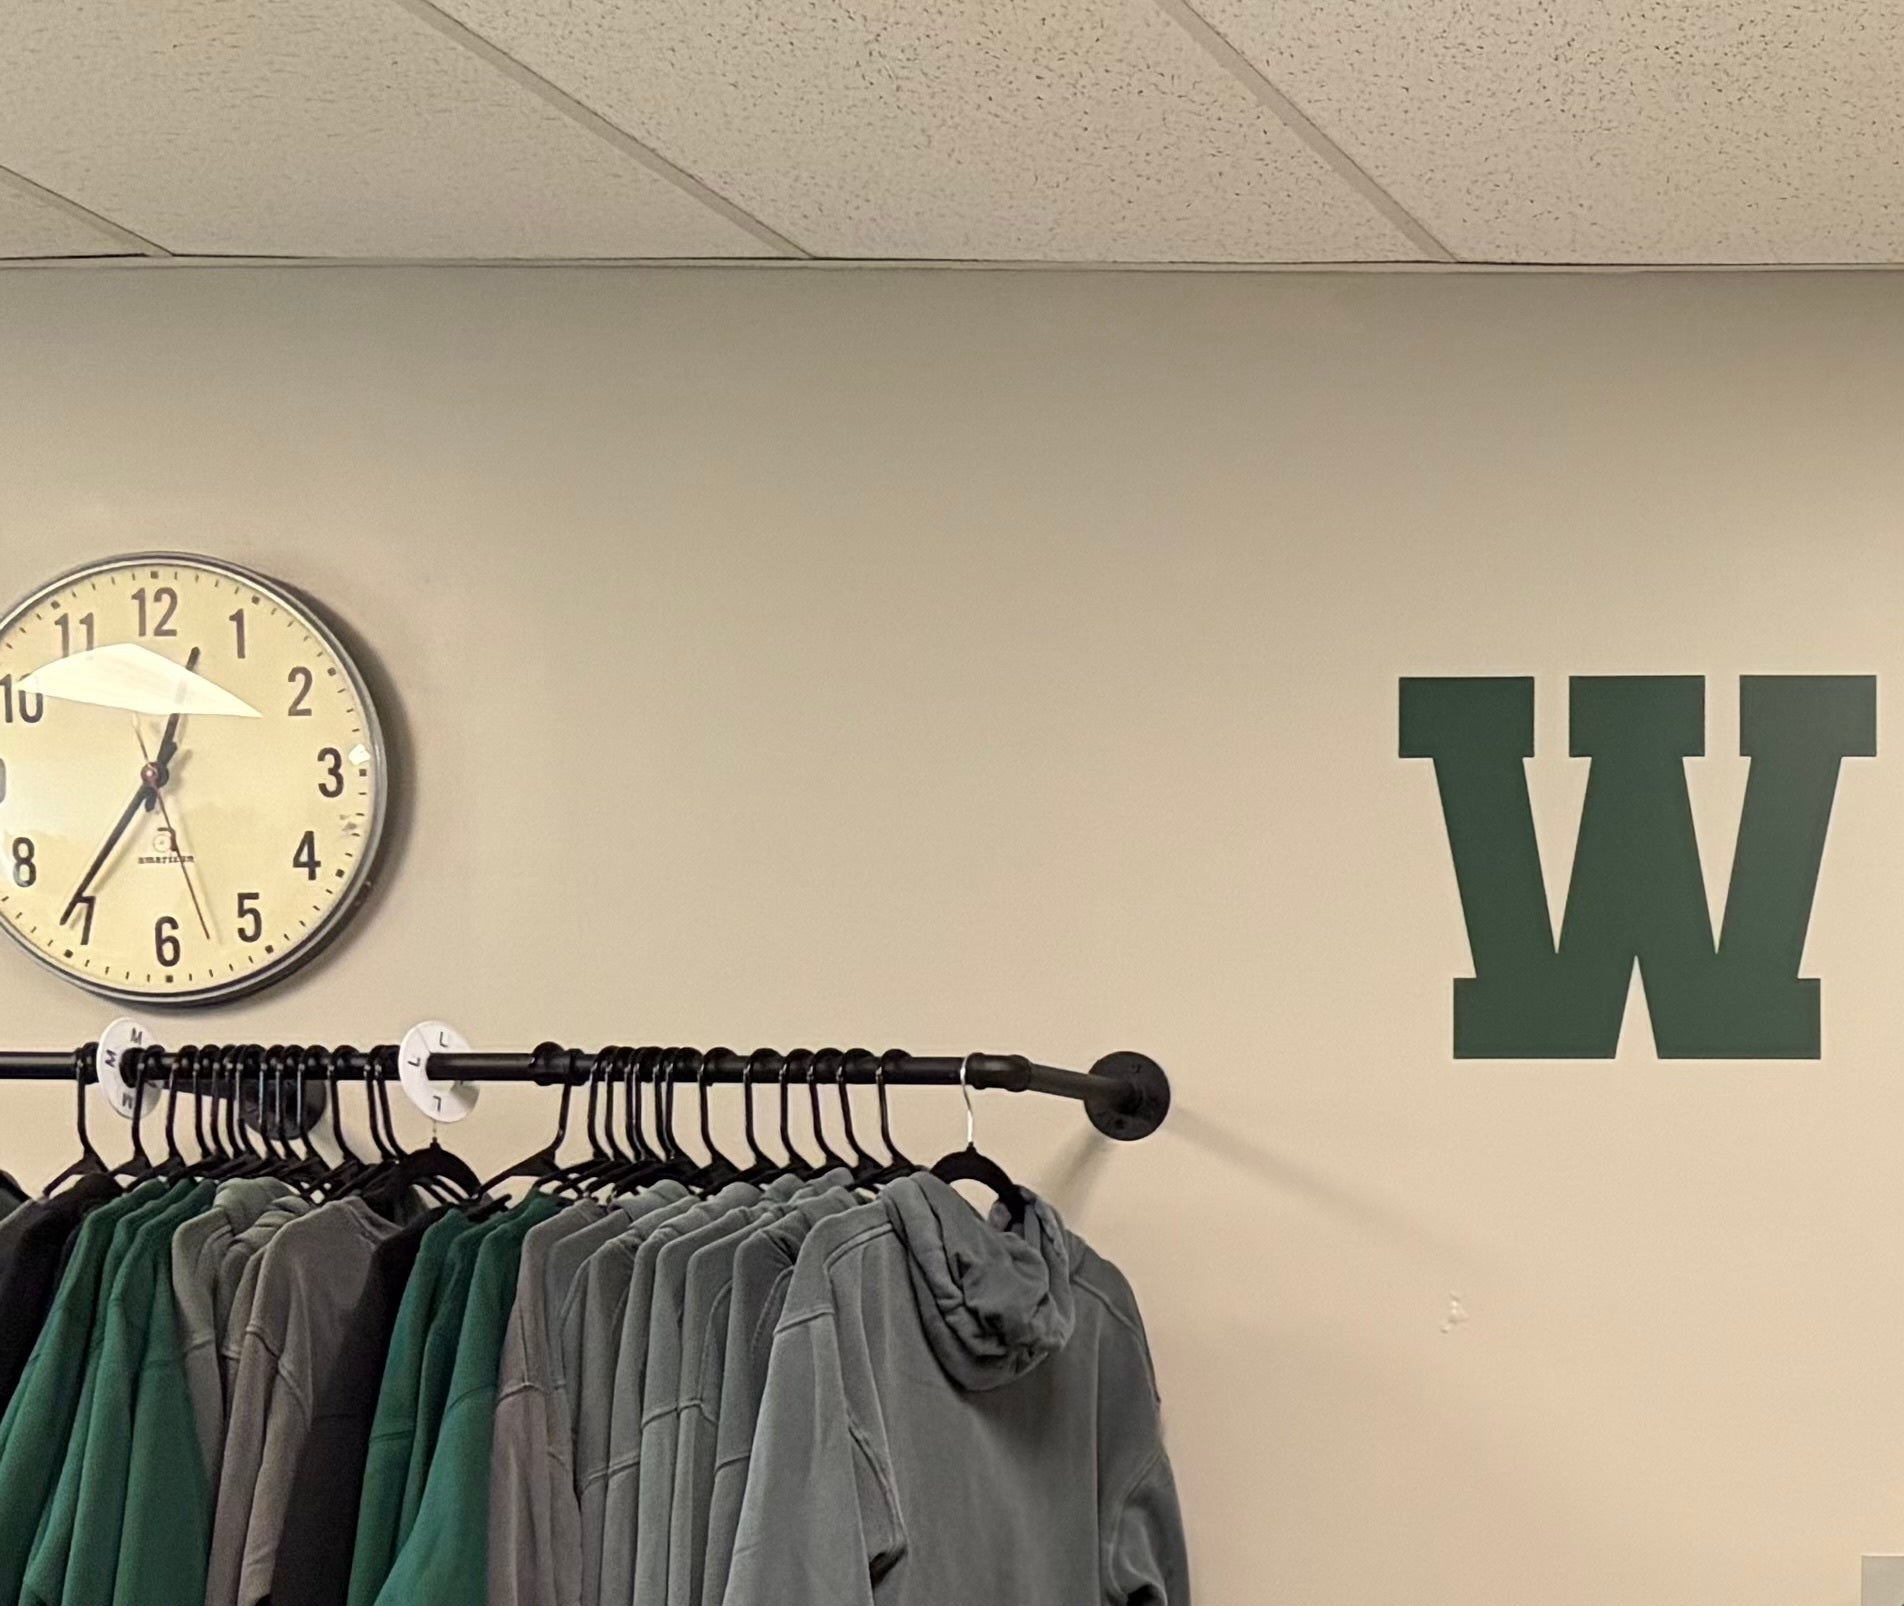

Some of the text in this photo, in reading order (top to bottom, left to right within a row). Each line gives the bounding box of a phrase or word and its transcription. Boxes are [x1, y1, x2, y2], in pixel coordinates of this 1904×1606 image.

[131, 587, 178, 636] 12
[229, 608, 246, 659] 1
[288, 666, 313, 717] 2
[317, 747, 344, 797] 3
[12, 837, 37, 887] 8
[292, 830, 322, 881] 4
[154, 916, 180, 967] 6
[237, 892, 262, 942] 5
[129, 1028, 143, 1046] M
